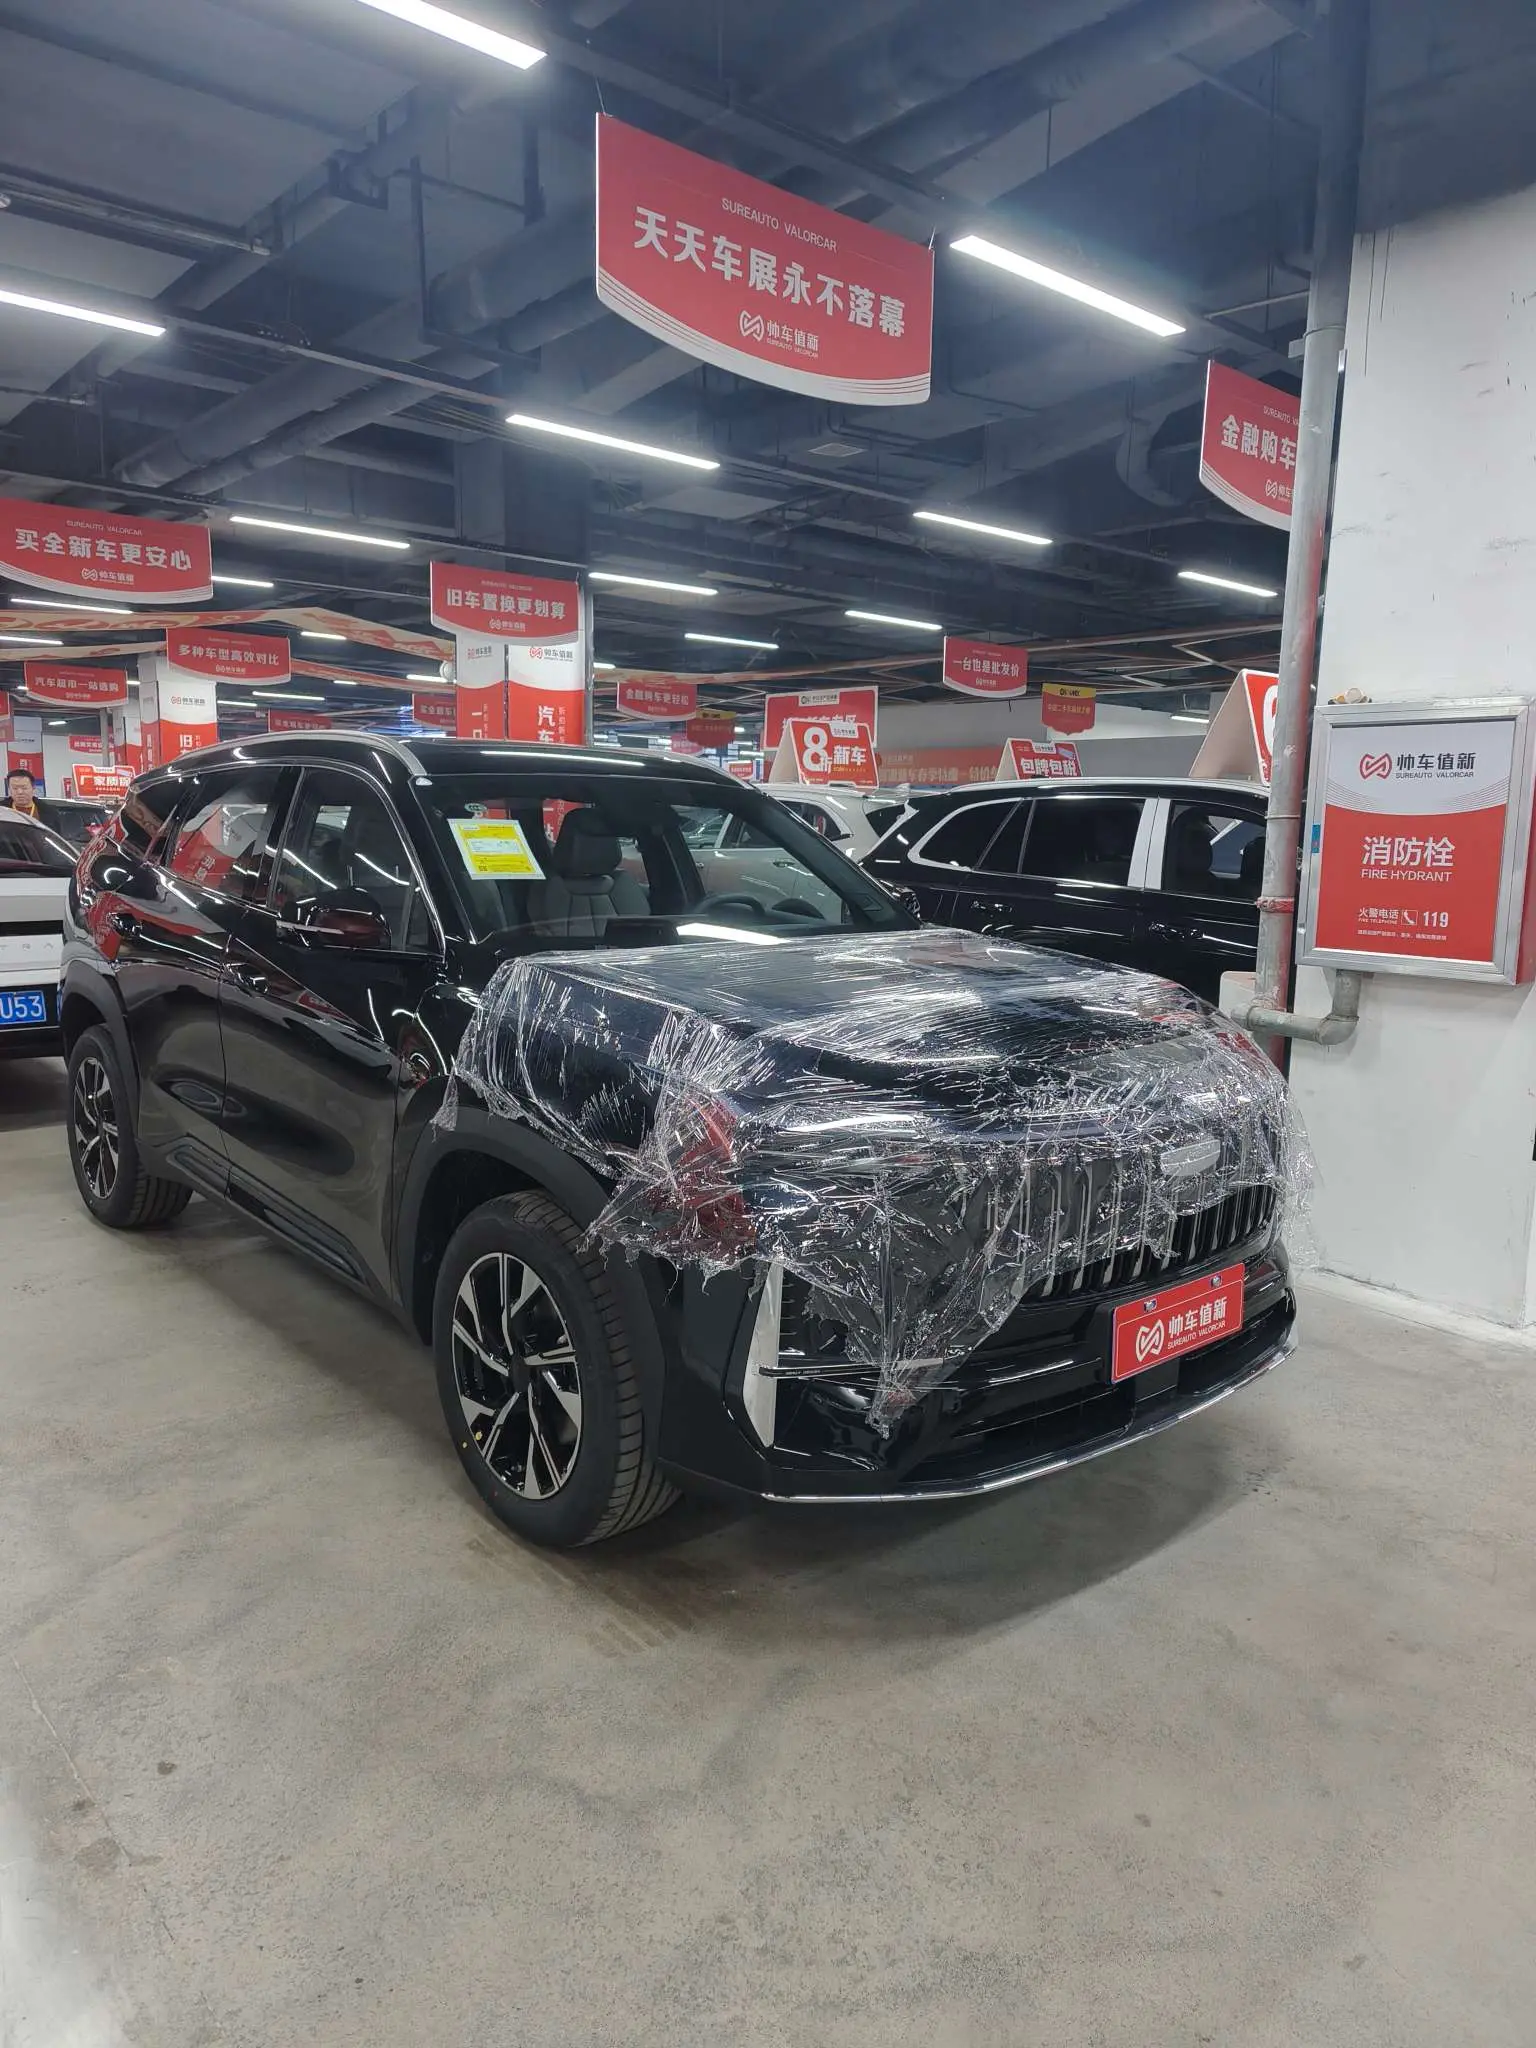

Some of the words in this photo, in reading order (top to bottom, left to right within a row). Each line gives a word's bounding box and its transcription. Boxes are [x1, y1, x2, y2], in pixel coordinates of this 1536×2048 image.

[722, 198, 780, 230] SUREAUTO
[784, 222, 838, 253] VALORCAR
[634, 206, 906, 338] 天天车展永不落幕
[766, 320, 819, 352] 帅车值新
[15, 528, 192, 571] 买全新车更安心
[446, 588, 566, 620] 旧车置换更划算
[178, 644, 280, 666] 多种车型高效对比
[953, 656, 1020, 678] 一台也是批发价
[34, 676, 119, 692] 汽车超市一站选购
[626, 688, 689, 706] 金融购车更轻松
[1020, 757, 1078, 777] 包牌包税
[1396, 752, 1477, 771] 帅车值新
[1395, 771, 1433, 779] SUREAUTO
[1436, 771, 1475, 779] VALORCAR
[1361, 836, 1456, 868] 消防栓
[1361, 868, 1388, 880] FIRE
[1391, 869, 1453, 882] HYDRANT
[1358, 907, 1399, 920] 火警电话
[1423, 911, 1449, 928] 119
[1168, 1296, 1227, 1339] 帅车值新
[1167, 1333, 1196, 1350] SUREAUTO
[1198, 1320, 1226, 1338] VALORCAR
